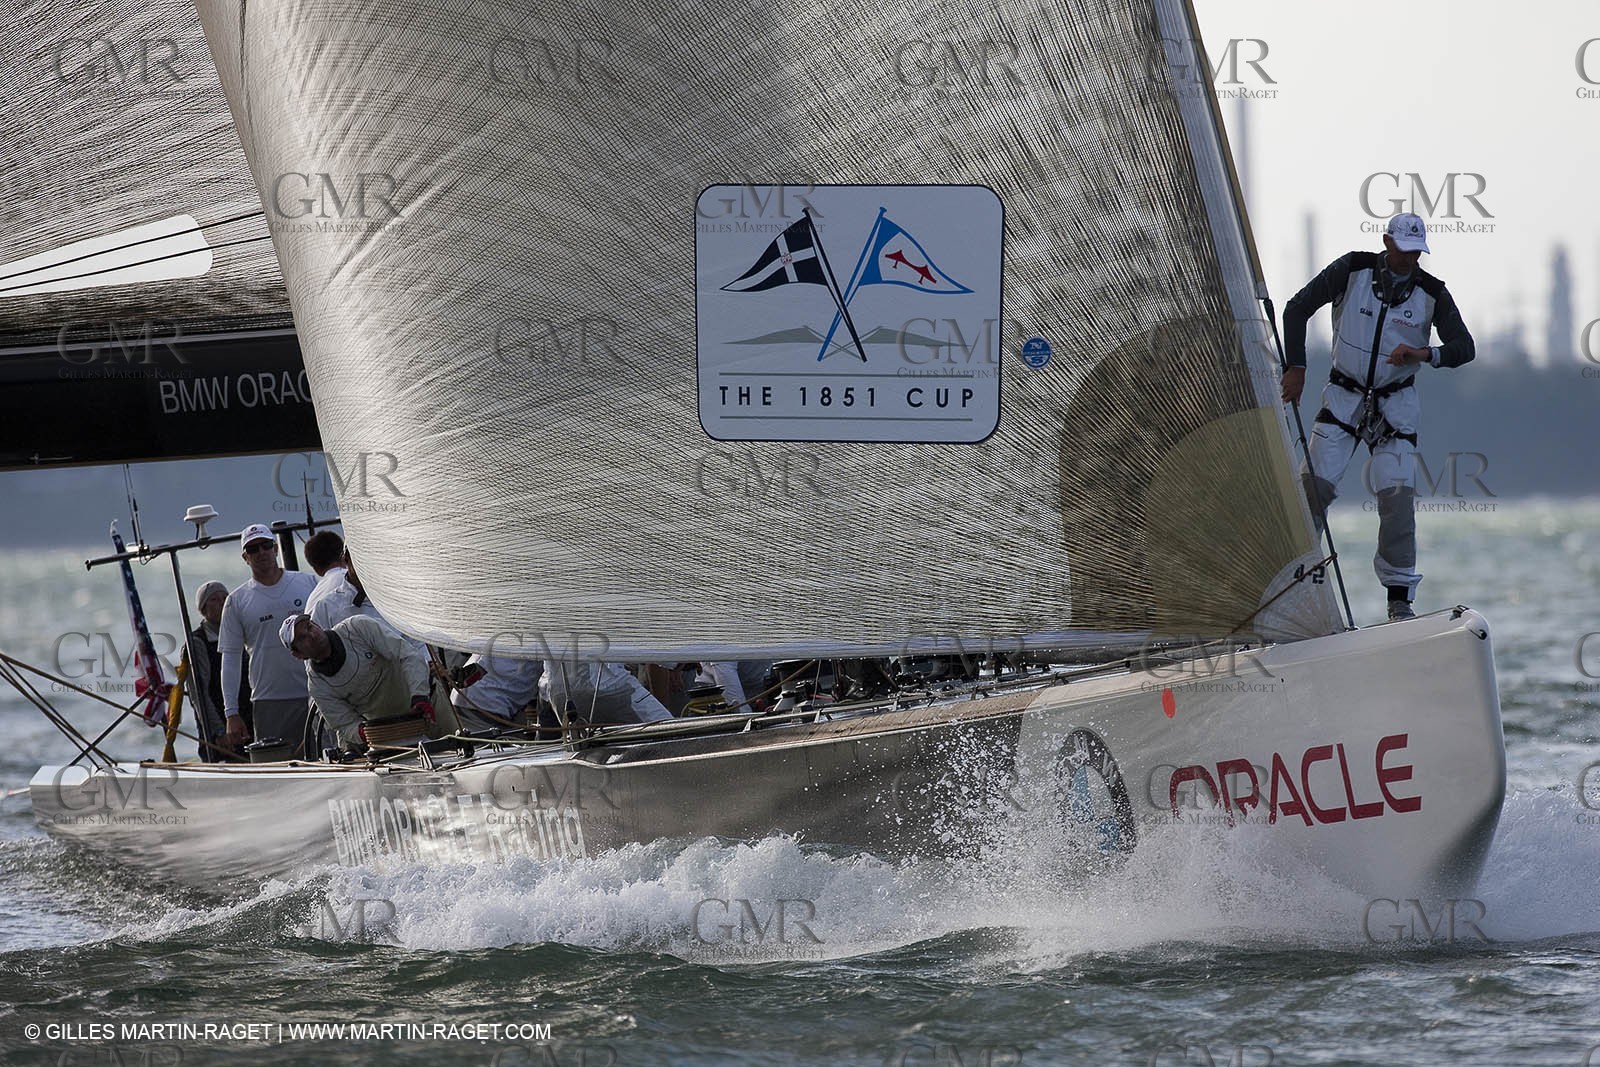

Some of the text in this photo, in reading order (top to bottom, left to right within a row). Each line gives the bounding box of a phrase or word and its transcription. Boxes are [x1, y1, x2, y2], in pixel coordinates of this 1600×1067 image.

[159, 376, 228, 413] BMW
[719, 386, 974, 408] THE 1851 CUP
[1169, 733, 1422, 828] ORACLE
